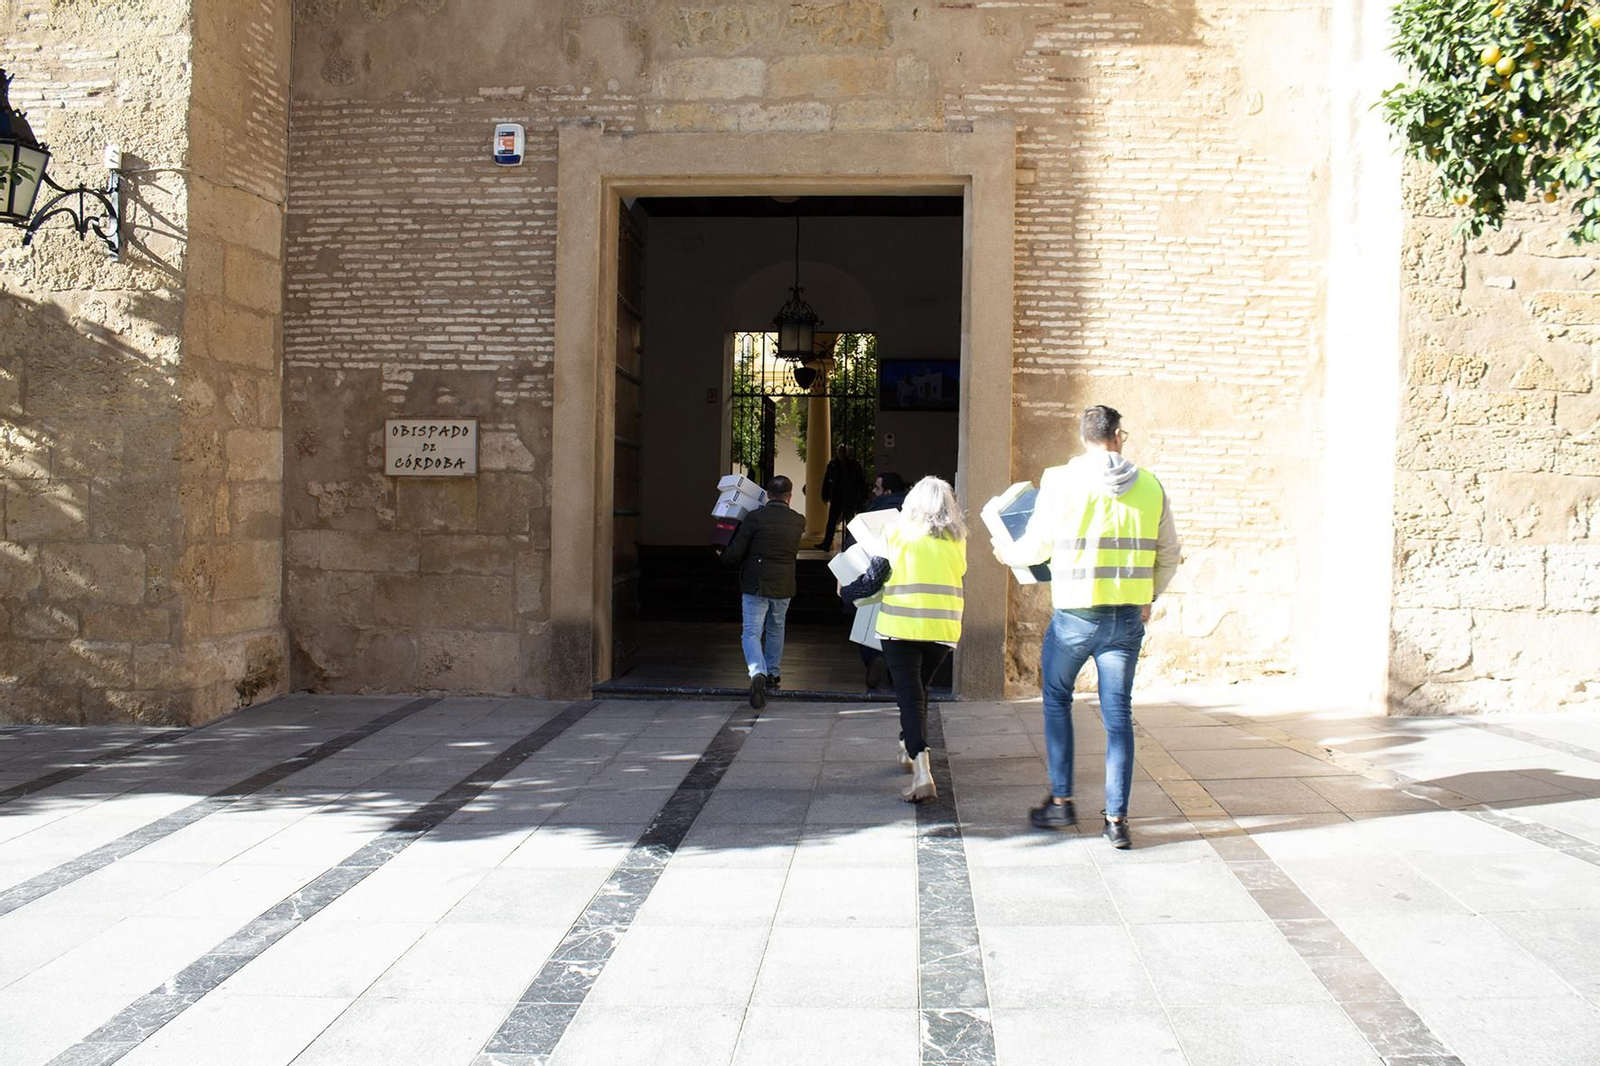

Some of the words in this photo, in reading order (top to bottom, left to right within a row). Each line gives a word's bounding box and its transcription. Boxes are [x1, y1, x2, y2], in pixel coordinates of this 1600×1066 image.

[392, 425, 469, 438] OBISPADO
[422, 443, 436, 452] DE
[394, 454, 466, 470] CÓRDOBA
